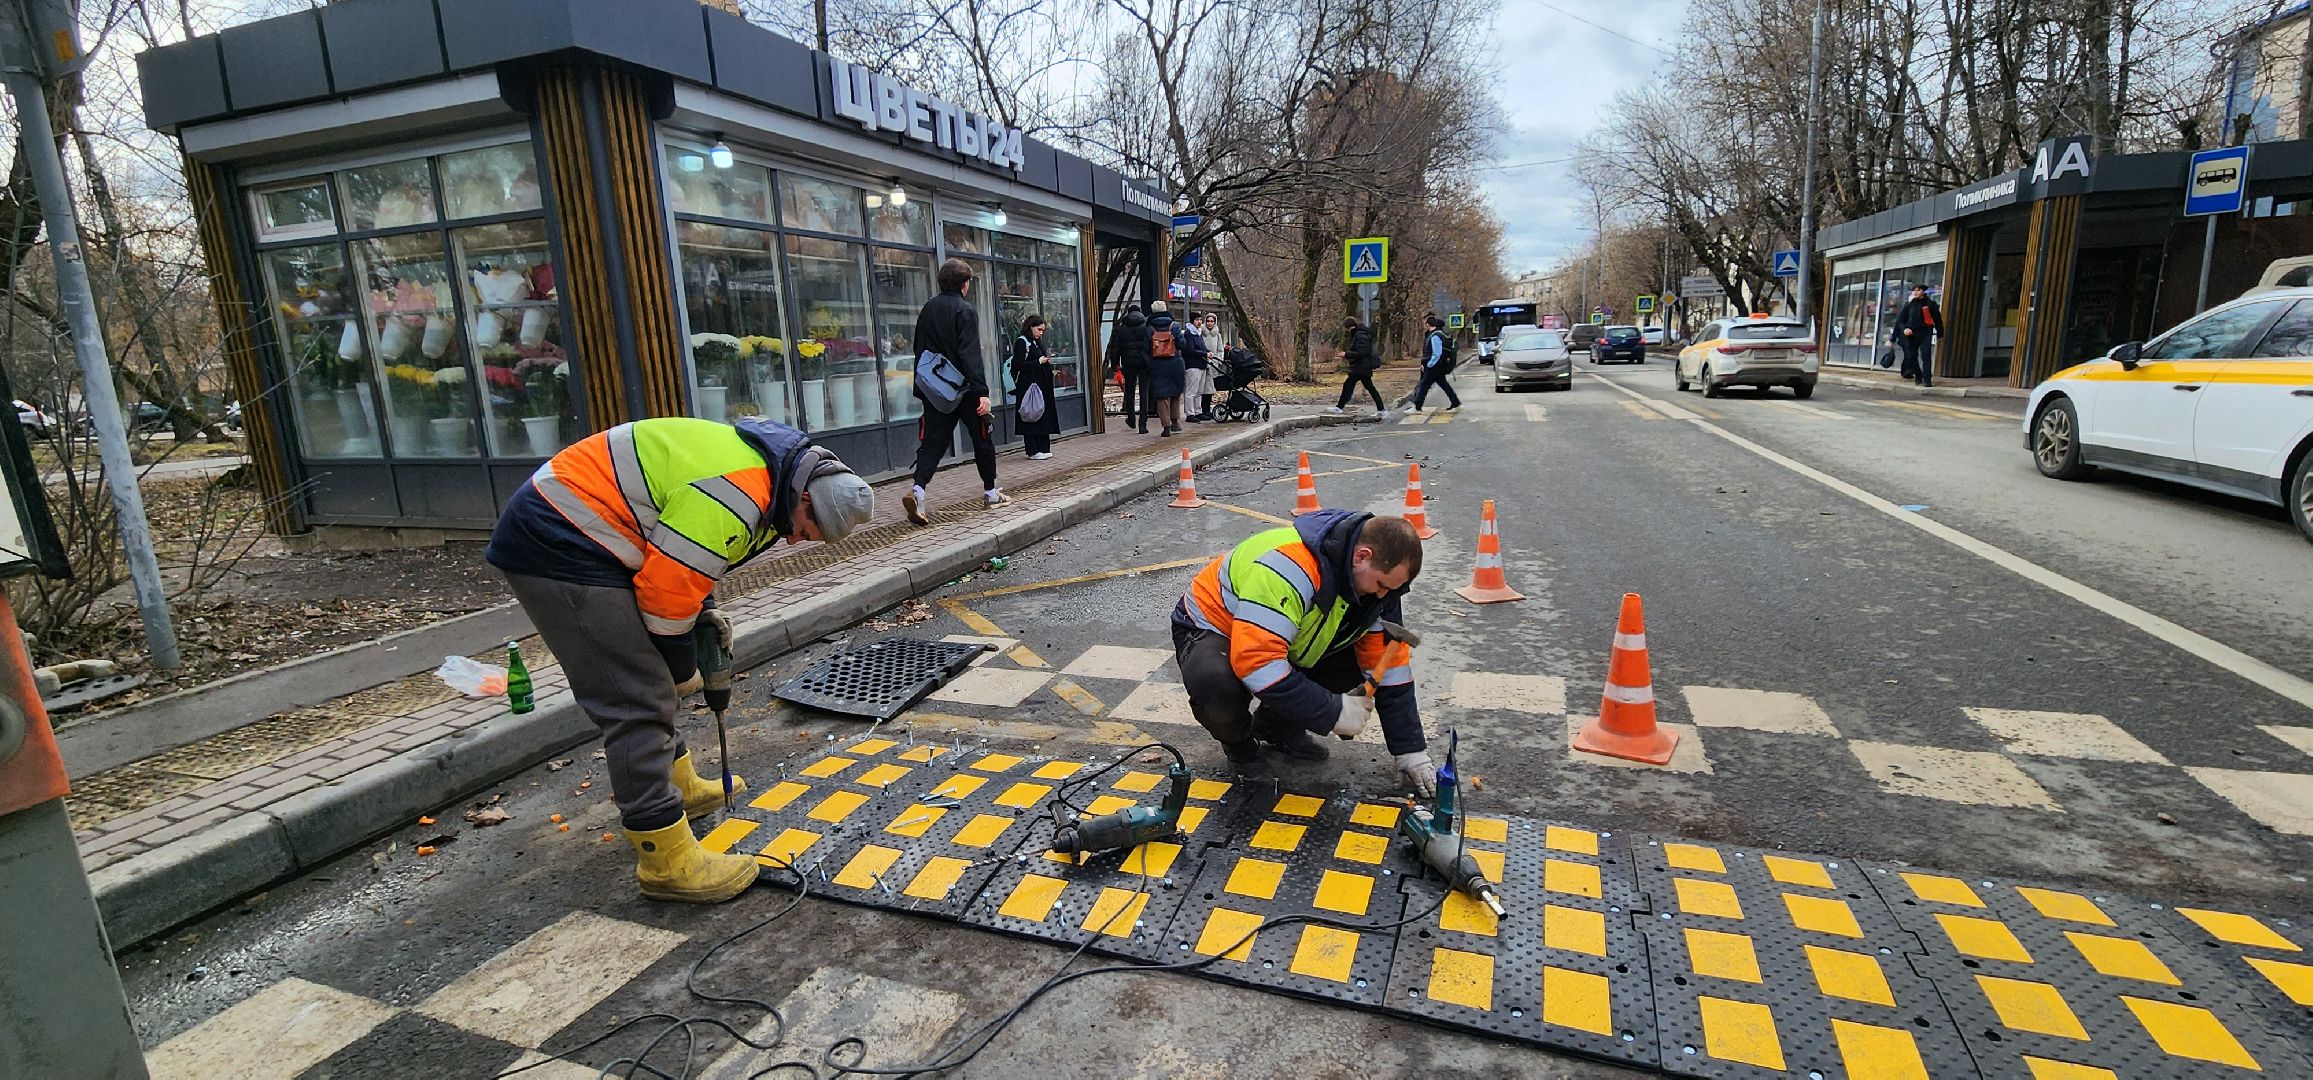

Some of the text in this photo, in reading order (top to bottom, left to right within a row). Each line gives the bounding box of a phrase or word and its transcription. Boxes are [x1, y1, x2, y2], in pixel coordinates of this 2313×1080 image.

[830, 58, 1024, 172] ЦВЕТЫ24
[1122, 179, 1173, 217] Поликлиника
[1955, 179, 2016, 210] Поликлиника
